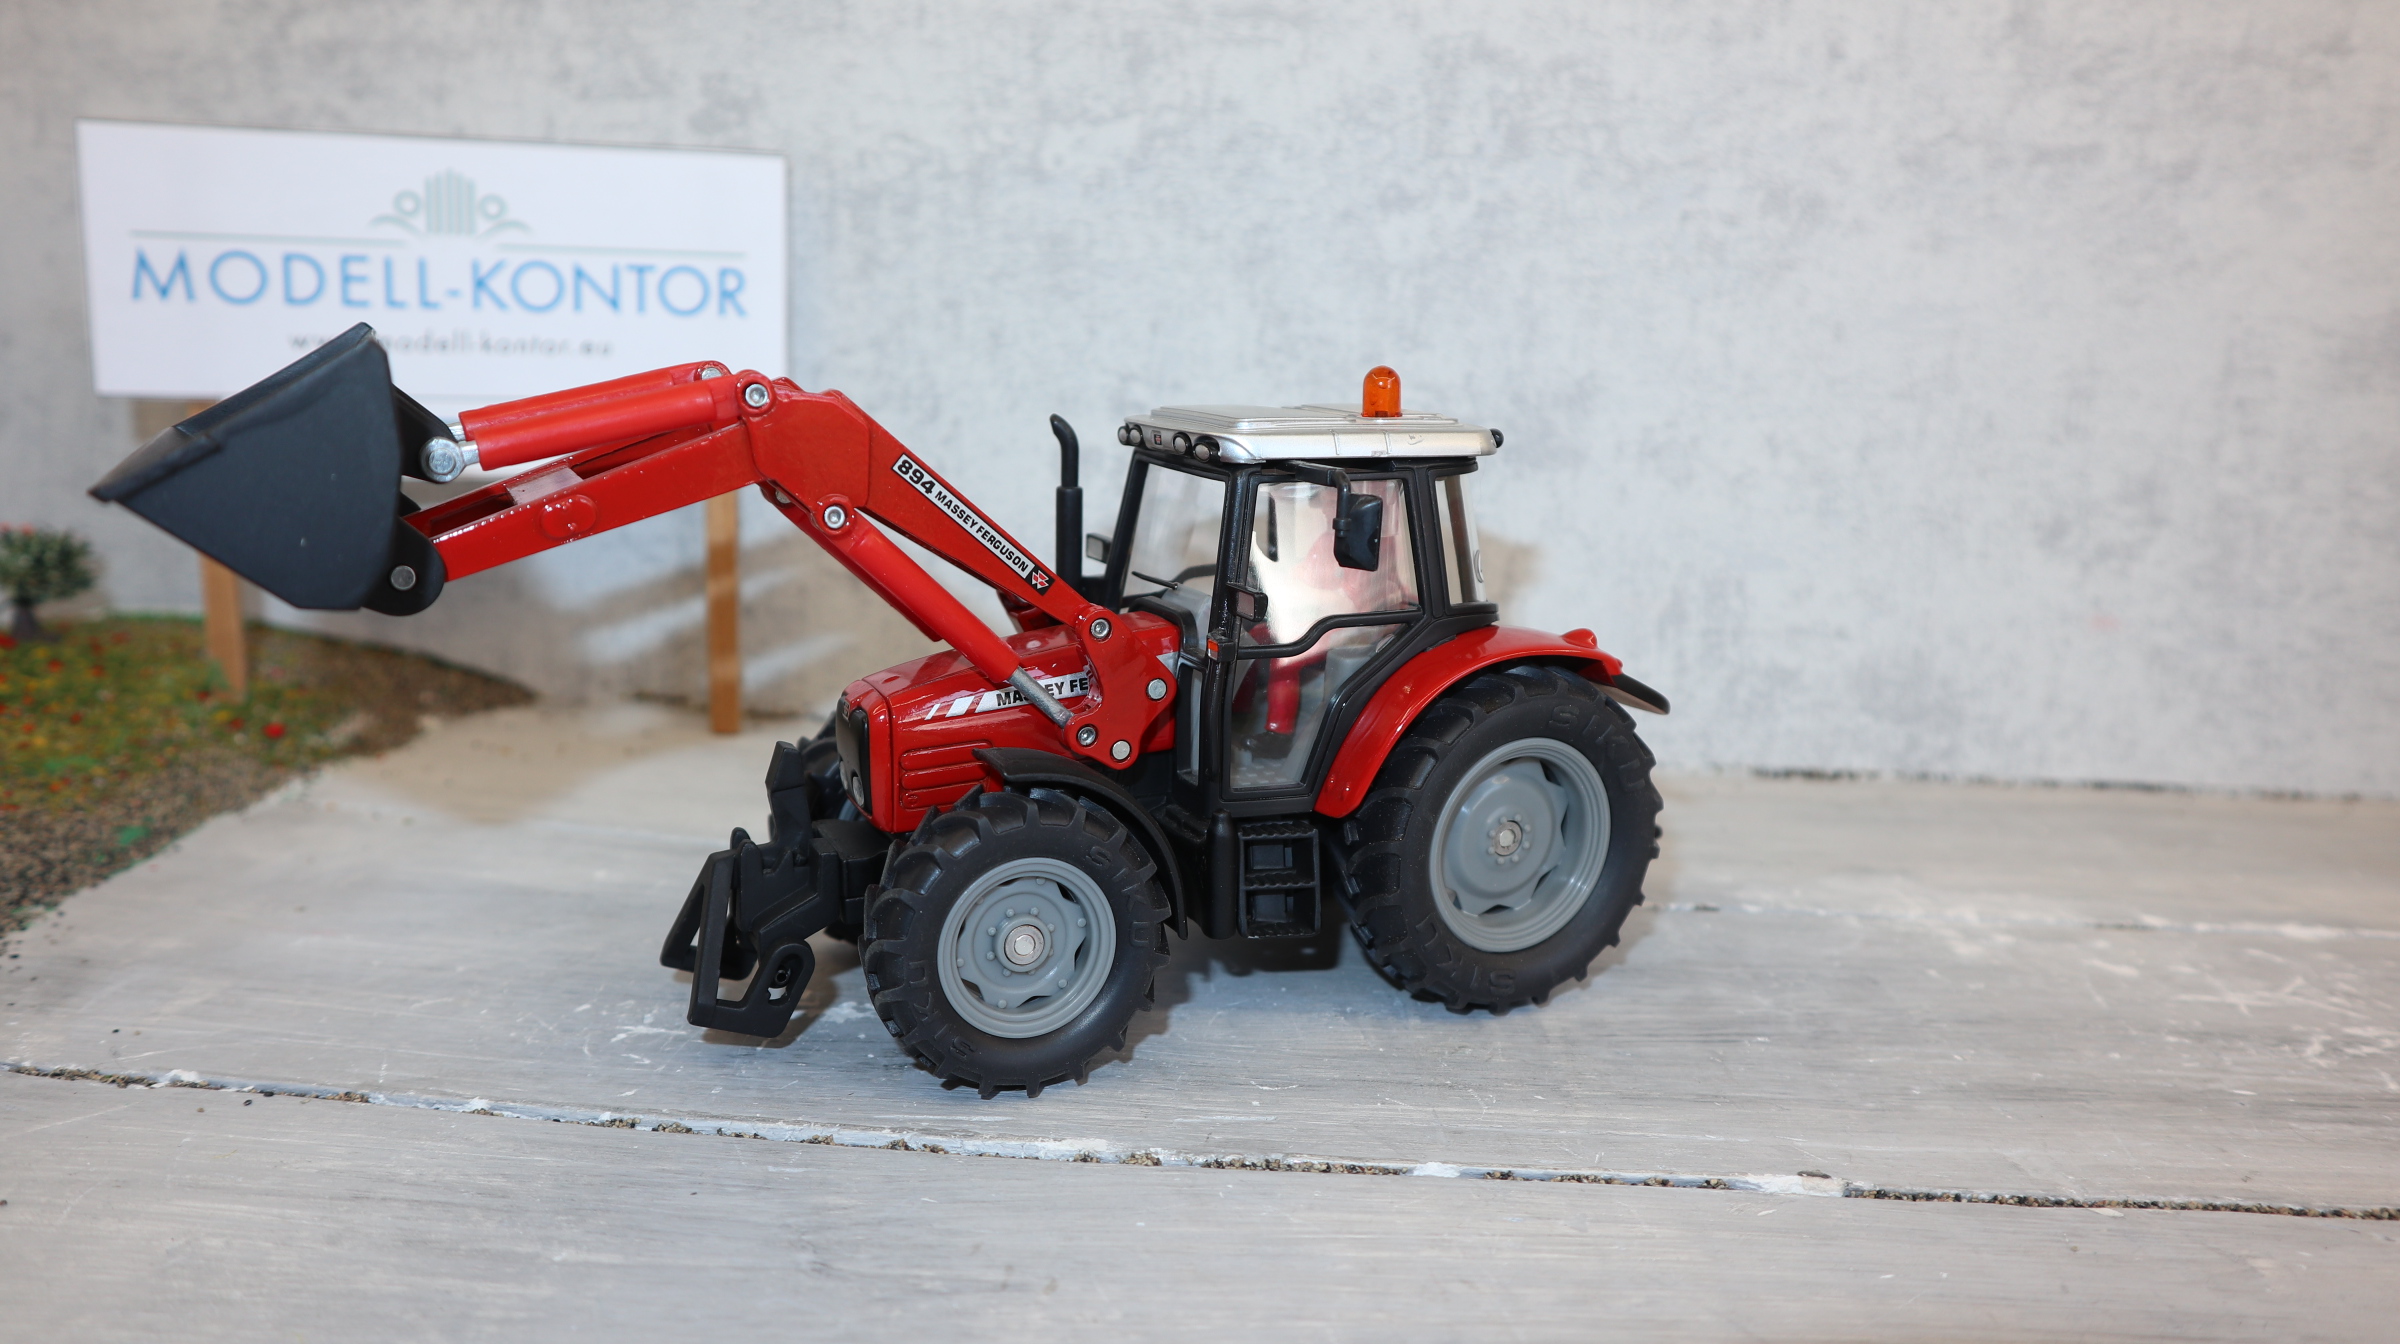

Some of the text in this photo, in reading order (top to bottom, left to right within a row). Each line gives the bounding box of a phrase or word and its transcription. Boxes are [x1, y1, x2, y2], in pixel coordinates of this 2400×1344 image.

[131, 248, 748, 318] MODELL-KONTOR
[897, 459, 1029, 572] 894 MASSEY FERGUSON
[996, 682, 1064, 706] MAEY
[1548, 704, 1646, 791] SIKU
[1085, 845, 1152, 948] SIKU
[907, 959, 977, 1061] SIKU
